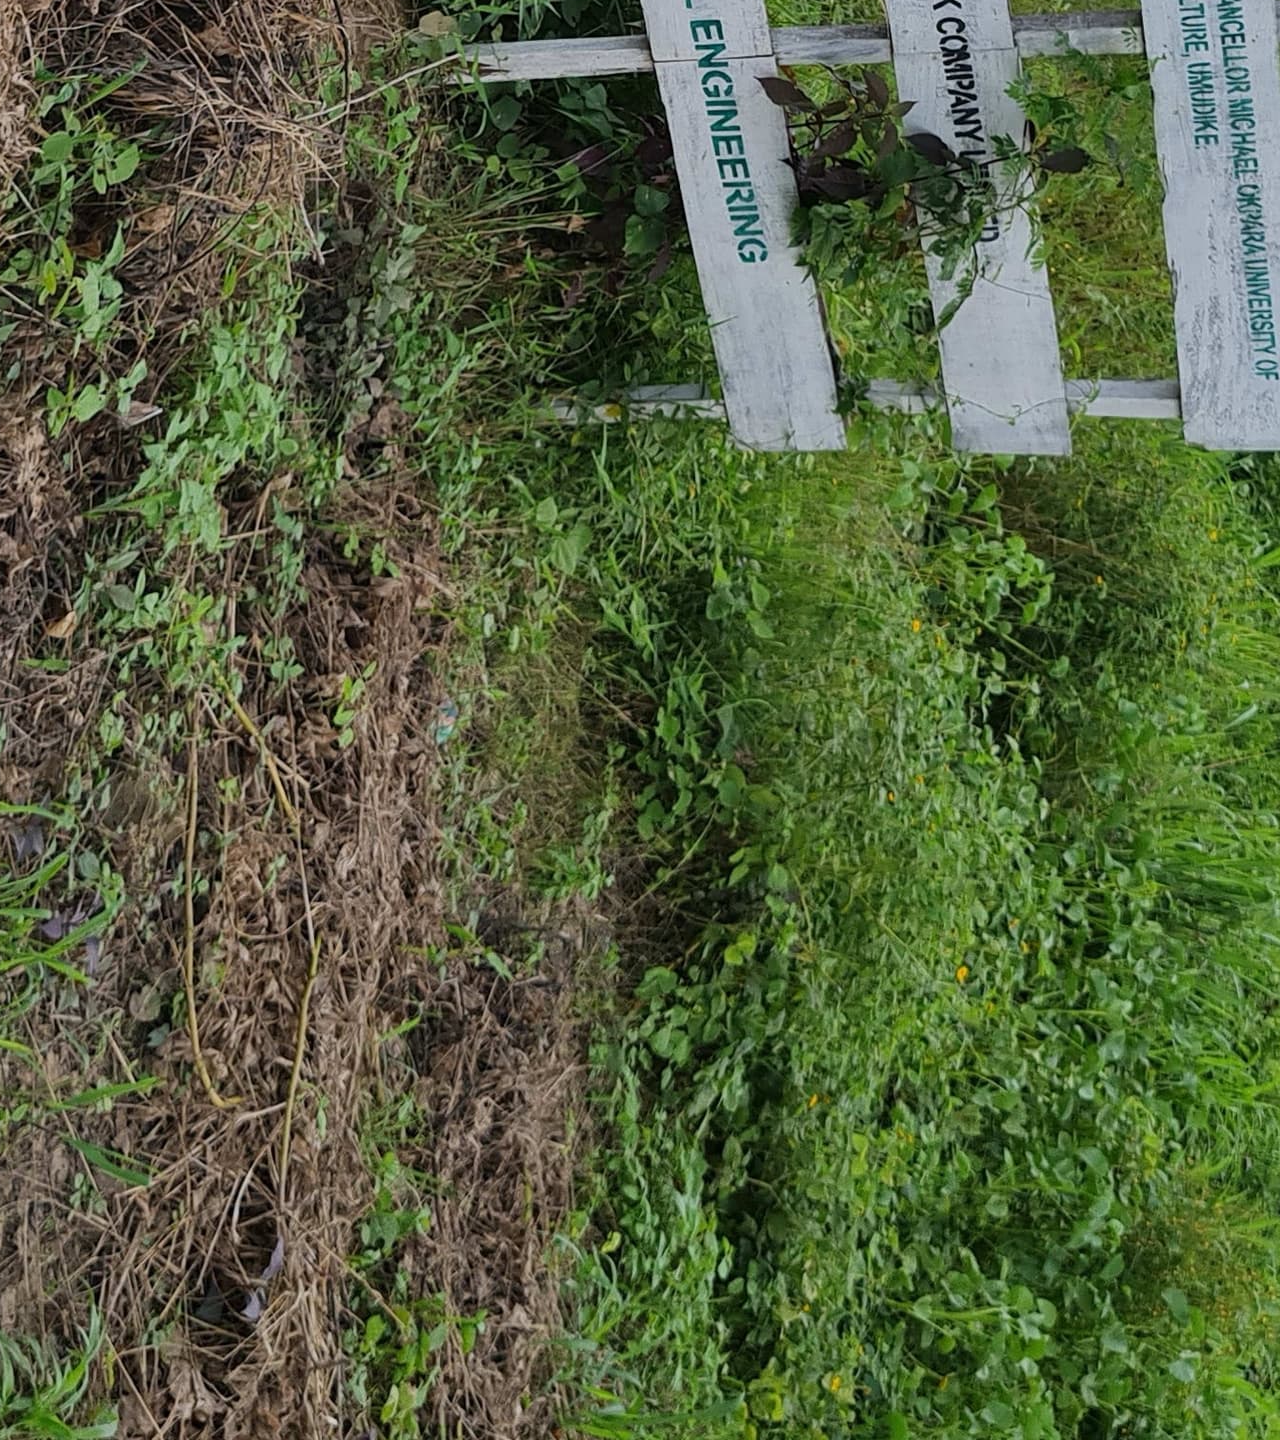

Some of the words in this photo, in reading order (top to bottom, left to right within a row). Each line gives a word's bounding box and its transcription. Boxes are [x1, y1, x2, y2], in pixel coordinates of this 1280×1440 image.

[936, 17, 985, 142] COMPANY
[689, 19, 769, 263] ENGINEERING
[1228, 98, 1259, 179] MICHAEL
[1236, 184, 1268, 255] OKPARA
[1243, 259, 1277, 355] UNIVERSITY
[1255, 360, 1279, 381] OF
